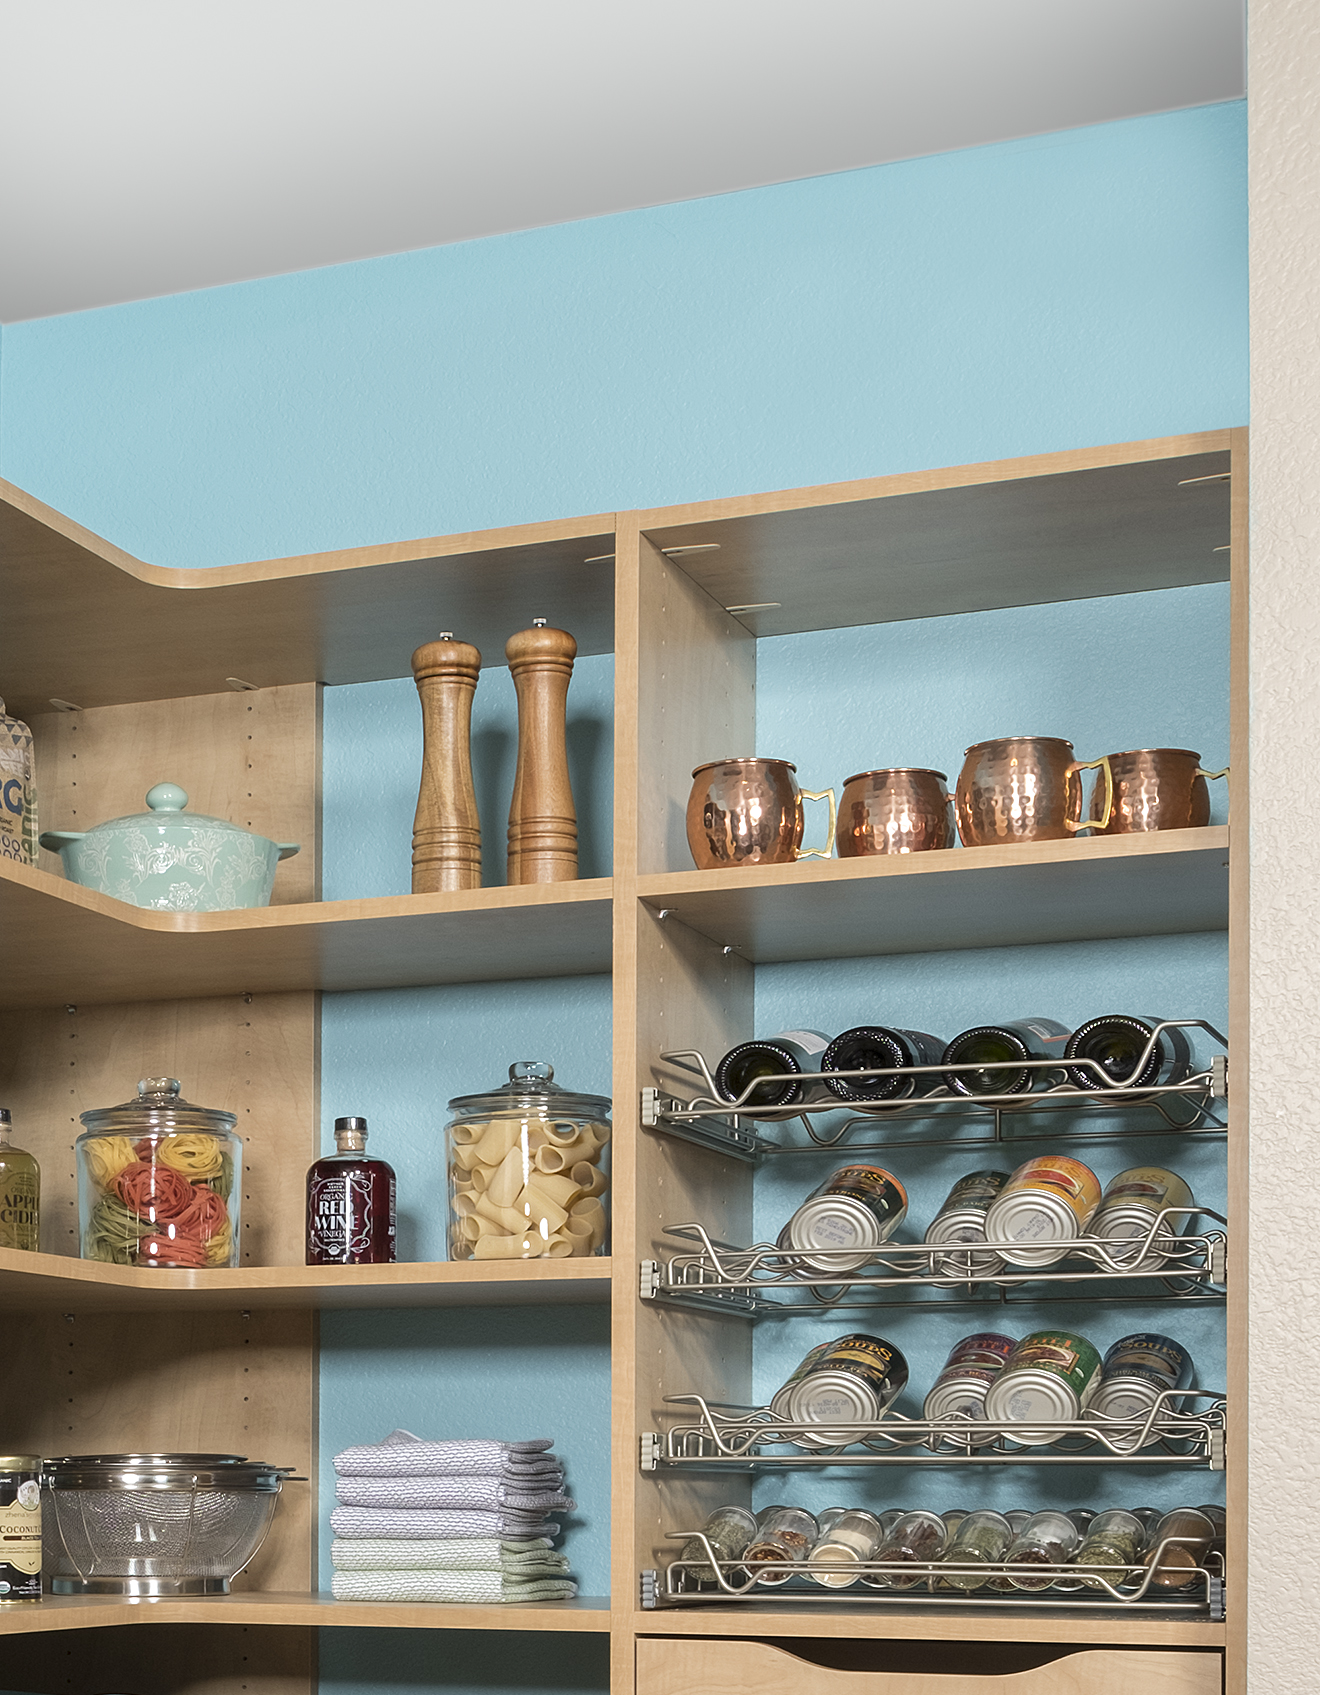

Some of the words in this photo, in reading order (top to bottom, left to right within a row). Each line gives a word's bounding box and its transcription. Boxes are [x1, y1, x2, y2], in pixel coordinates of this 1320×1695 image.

[319, 1200, 354, 1215] RED
[315, 1215, 359, 1230] WINE
[0, 1525, 37, 1534] COCONUT
